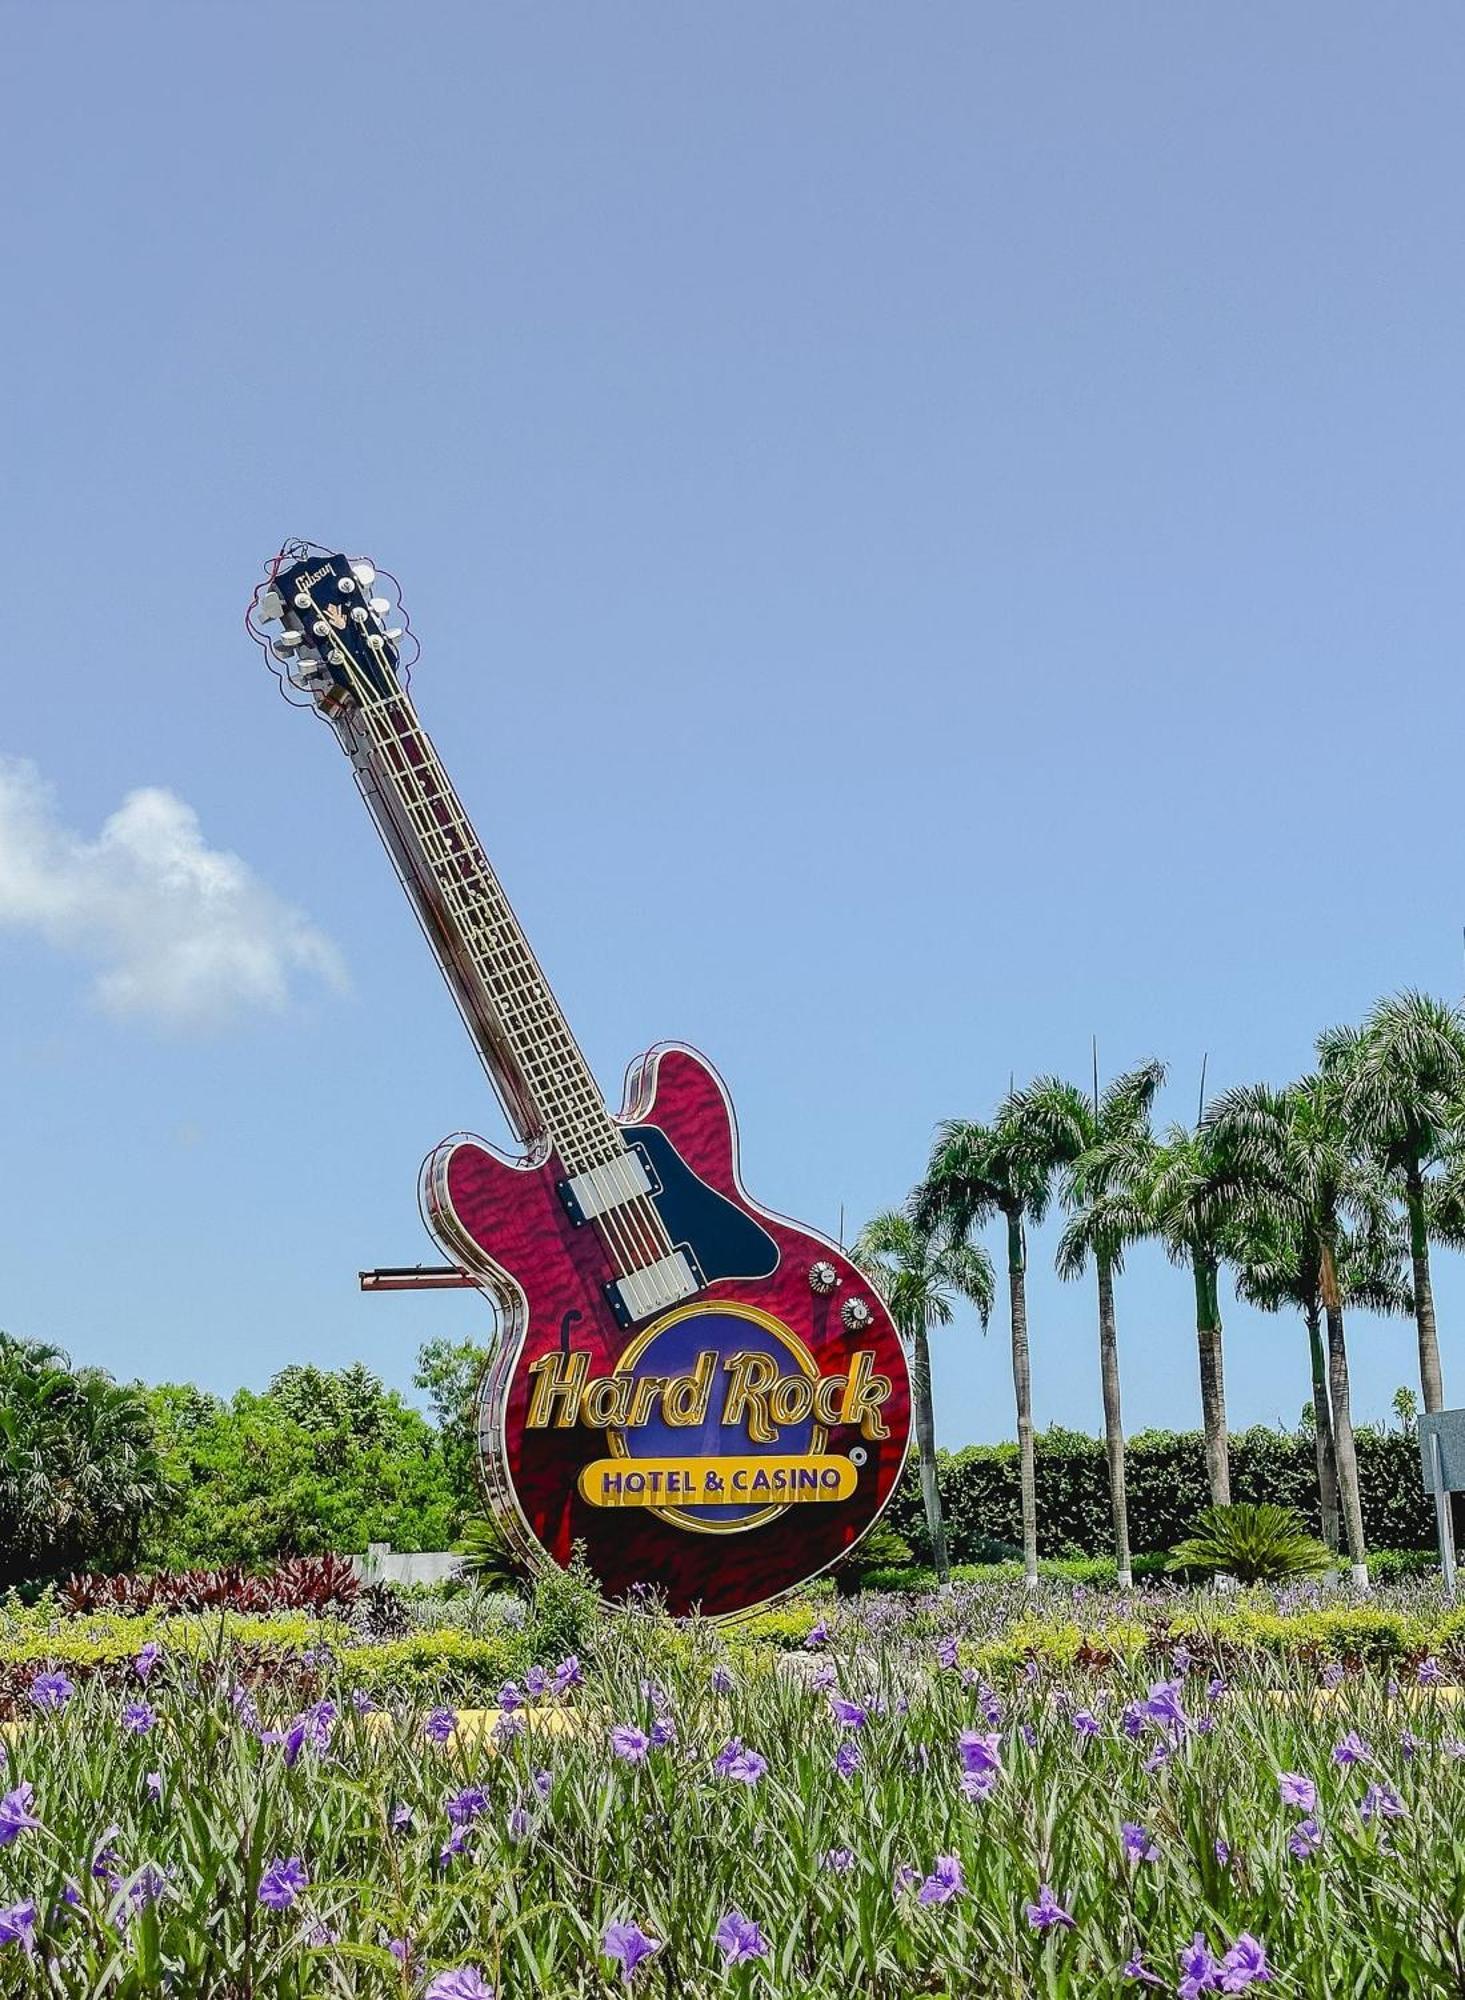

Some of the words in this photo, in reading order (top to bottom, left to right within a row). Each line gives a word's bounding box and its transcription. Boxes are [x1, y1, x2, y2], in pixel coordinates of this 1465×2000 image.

[295, 562, 336, 592] Gibson
[525, 1351, 719, 1429] Hard
[722, 1350, 893, 1443] Rock
[603, 1471, 696, 1493] HOTEL
[704, 1470, 725, 1491] &
[732, 1468, 841, 1491] CASINO
